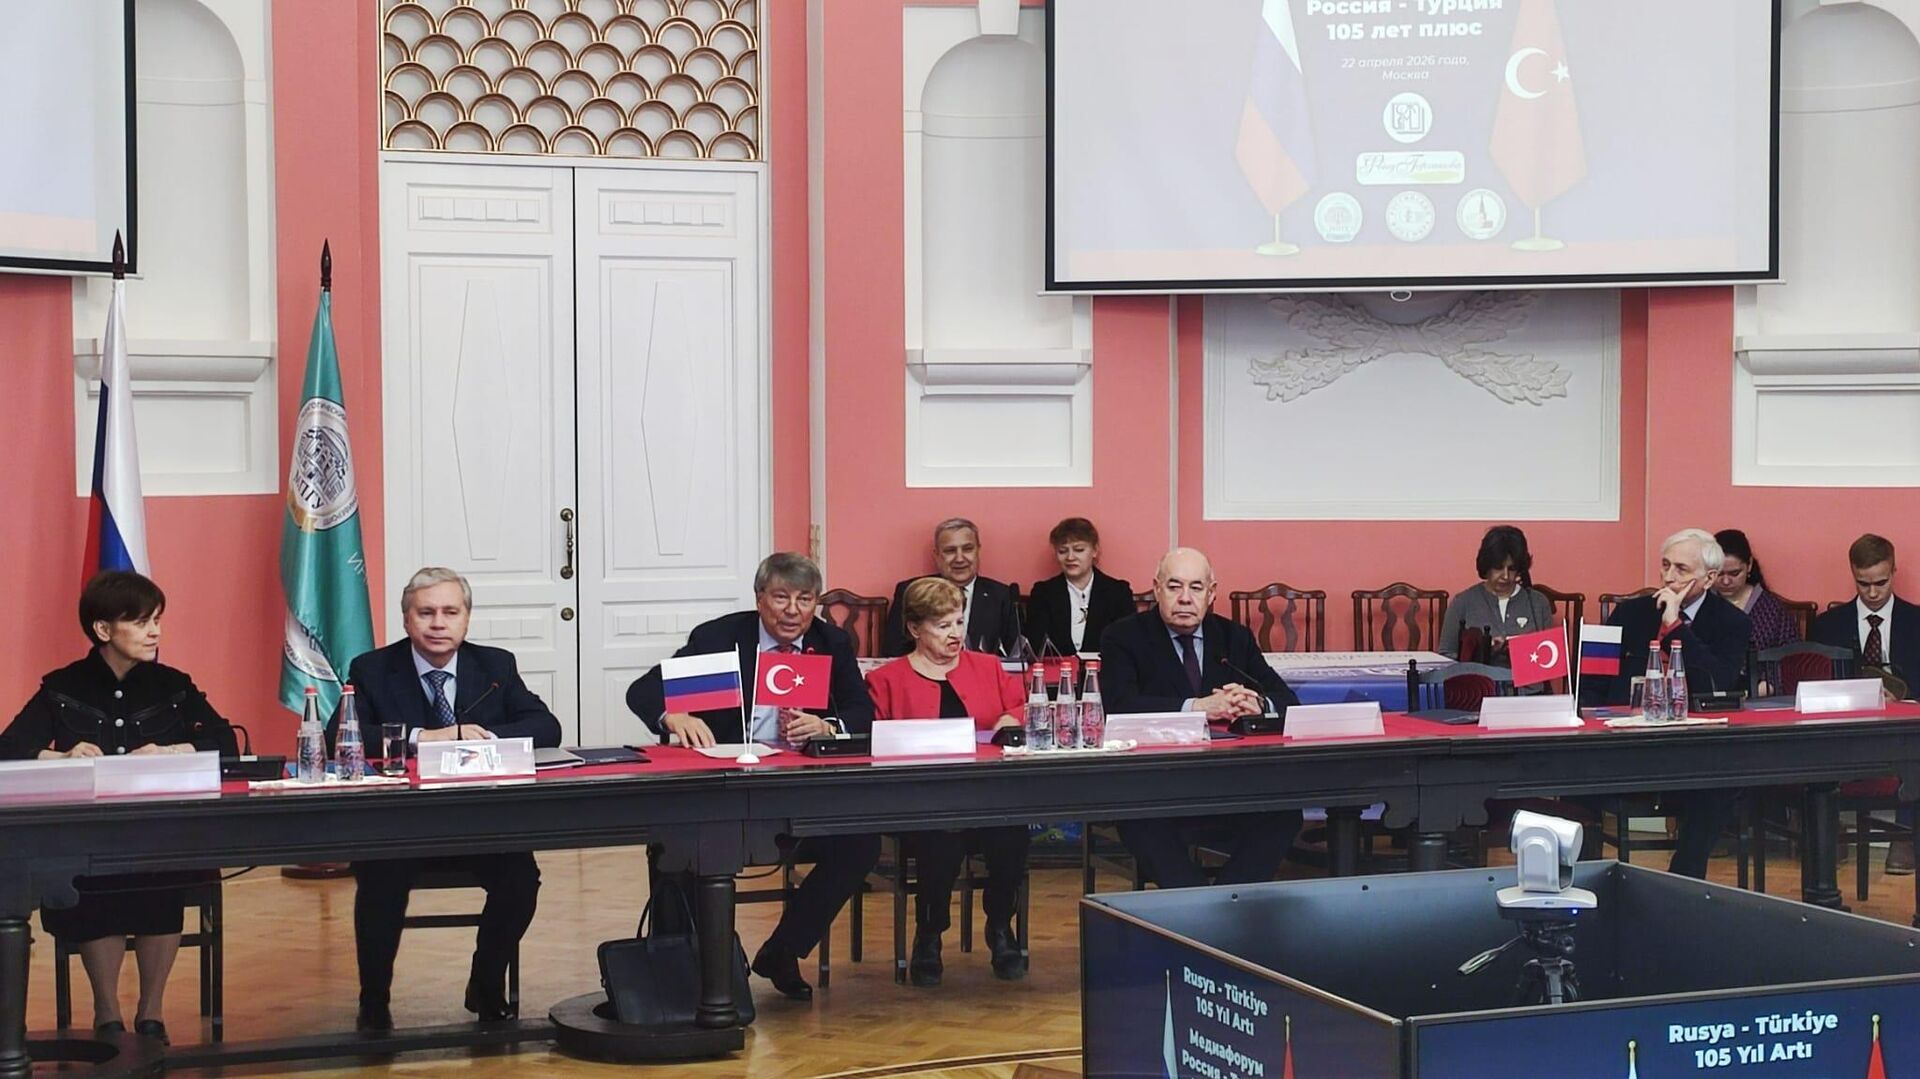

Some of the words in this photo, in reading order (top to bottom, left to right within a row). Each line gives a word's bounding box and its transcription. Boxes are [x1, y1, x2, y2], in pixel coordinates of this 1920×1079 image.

[1307, 0, 1391, 15] Россия
[1327, 24, 1364, 41] 105
[1371, 25, 1412, 39] лет
[1420, 21, 1482, 38] плюс
[1341, 58, 1357, 69] 22
[1359, 57, 1404, 69] апреля
[1406, 55, 1436, 67] 2026
[1382, 69, 1430, 82] Москва
[1184, 966, 1216, 995] Rusya
[1225, 983, 1268, 1016] Türkiye
[1196, 996, 1214, 1018] 105
[1216, 1004, 1230, 1026] Yıl
[1232, 1013, 1254, 1036] Artı
[1668, 1024, 1735, 1045] Rusya
[1755, 1010, 1838, 1035] Türkiye
[1182, 1049, 1221, 1079] Россия
[1189, 1028, 1264, 1077] Медиафорум
[1695, 1048, 1731, 1068] 105
[1736, 1044, 1764, 1064] Yıl
[1770, 1042, 1812, 1062] Artı
